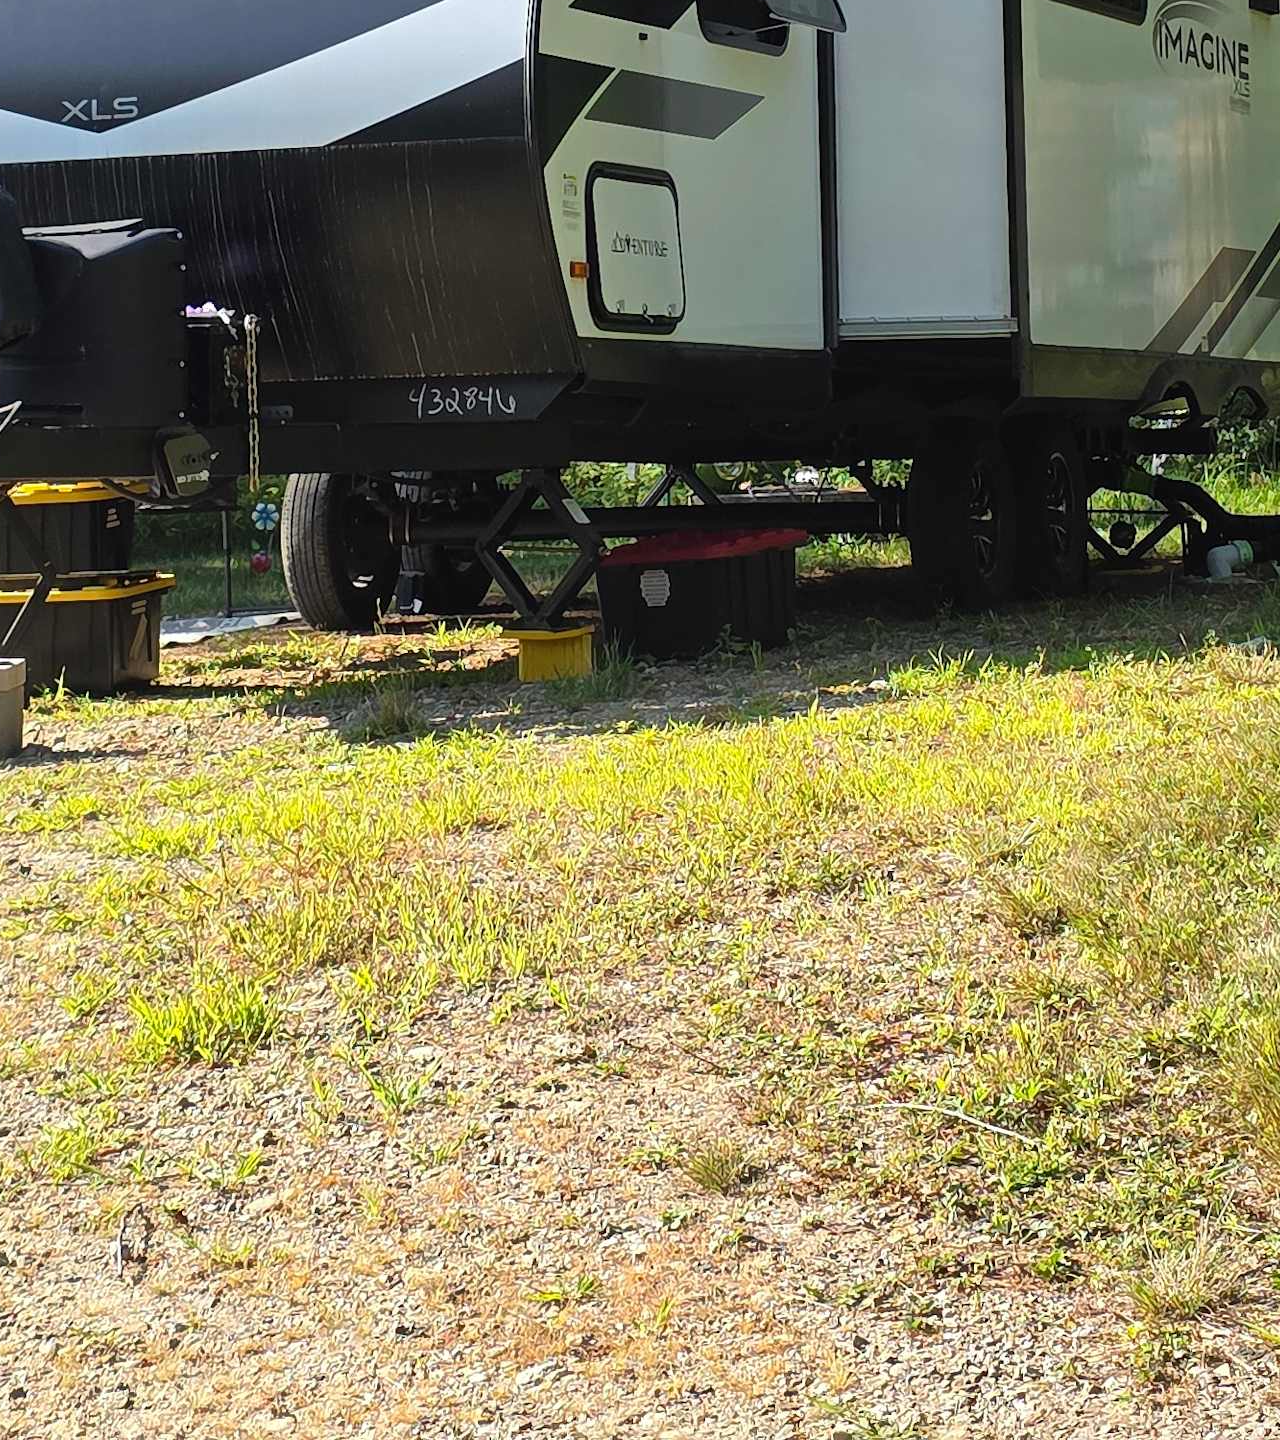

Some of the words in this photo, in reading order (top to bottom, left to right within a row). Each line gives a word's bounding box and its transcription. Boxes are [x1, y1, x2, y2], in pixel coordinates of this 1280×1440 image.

[1158, 17, 1249, 81] IMAGINE
[1233, 79, 1250, 97] XLS
[61, 96, 139, 122] XLS
[409, 383, 517, 420] 432846
